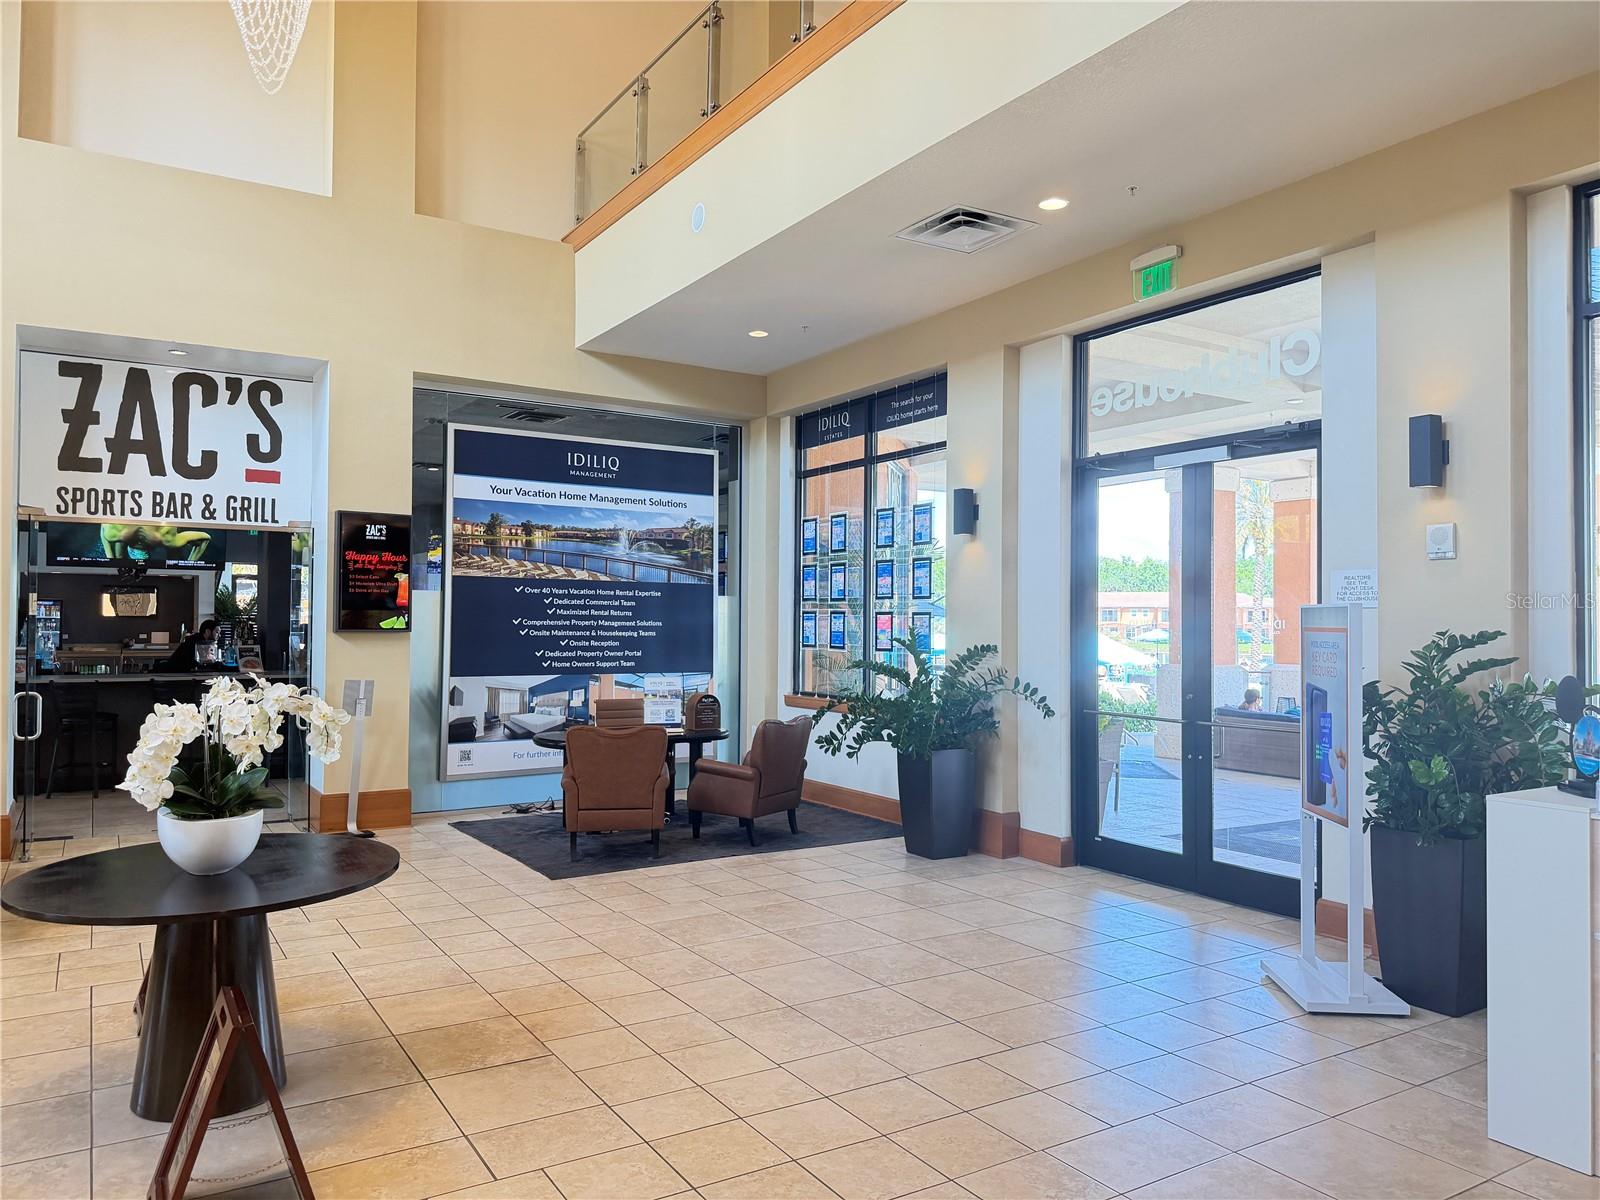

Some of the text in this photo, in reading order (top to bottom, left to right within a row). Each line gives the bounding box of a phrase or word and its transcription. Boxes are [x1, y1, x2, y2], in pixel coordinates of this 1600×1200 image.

[1143, 262, 1172, 297] EXIT
[57, 360, 283, 480] ZAC'S
[818, 411, 851, 432] IDILIQ
[567, 452, 620, 471] IDILIQ
[570, 470, 616, 479] MANAGEMENT
[56, 486, 280, 524] SPORTS BAR & GRILL
[490, 484, 688, 509] Your Vacation Home Management Solutions
[366, 524, 386, 536] ZAC'S
[345, 551, 408, 564] Happy Hour
[527, 750, 551, 758] further
